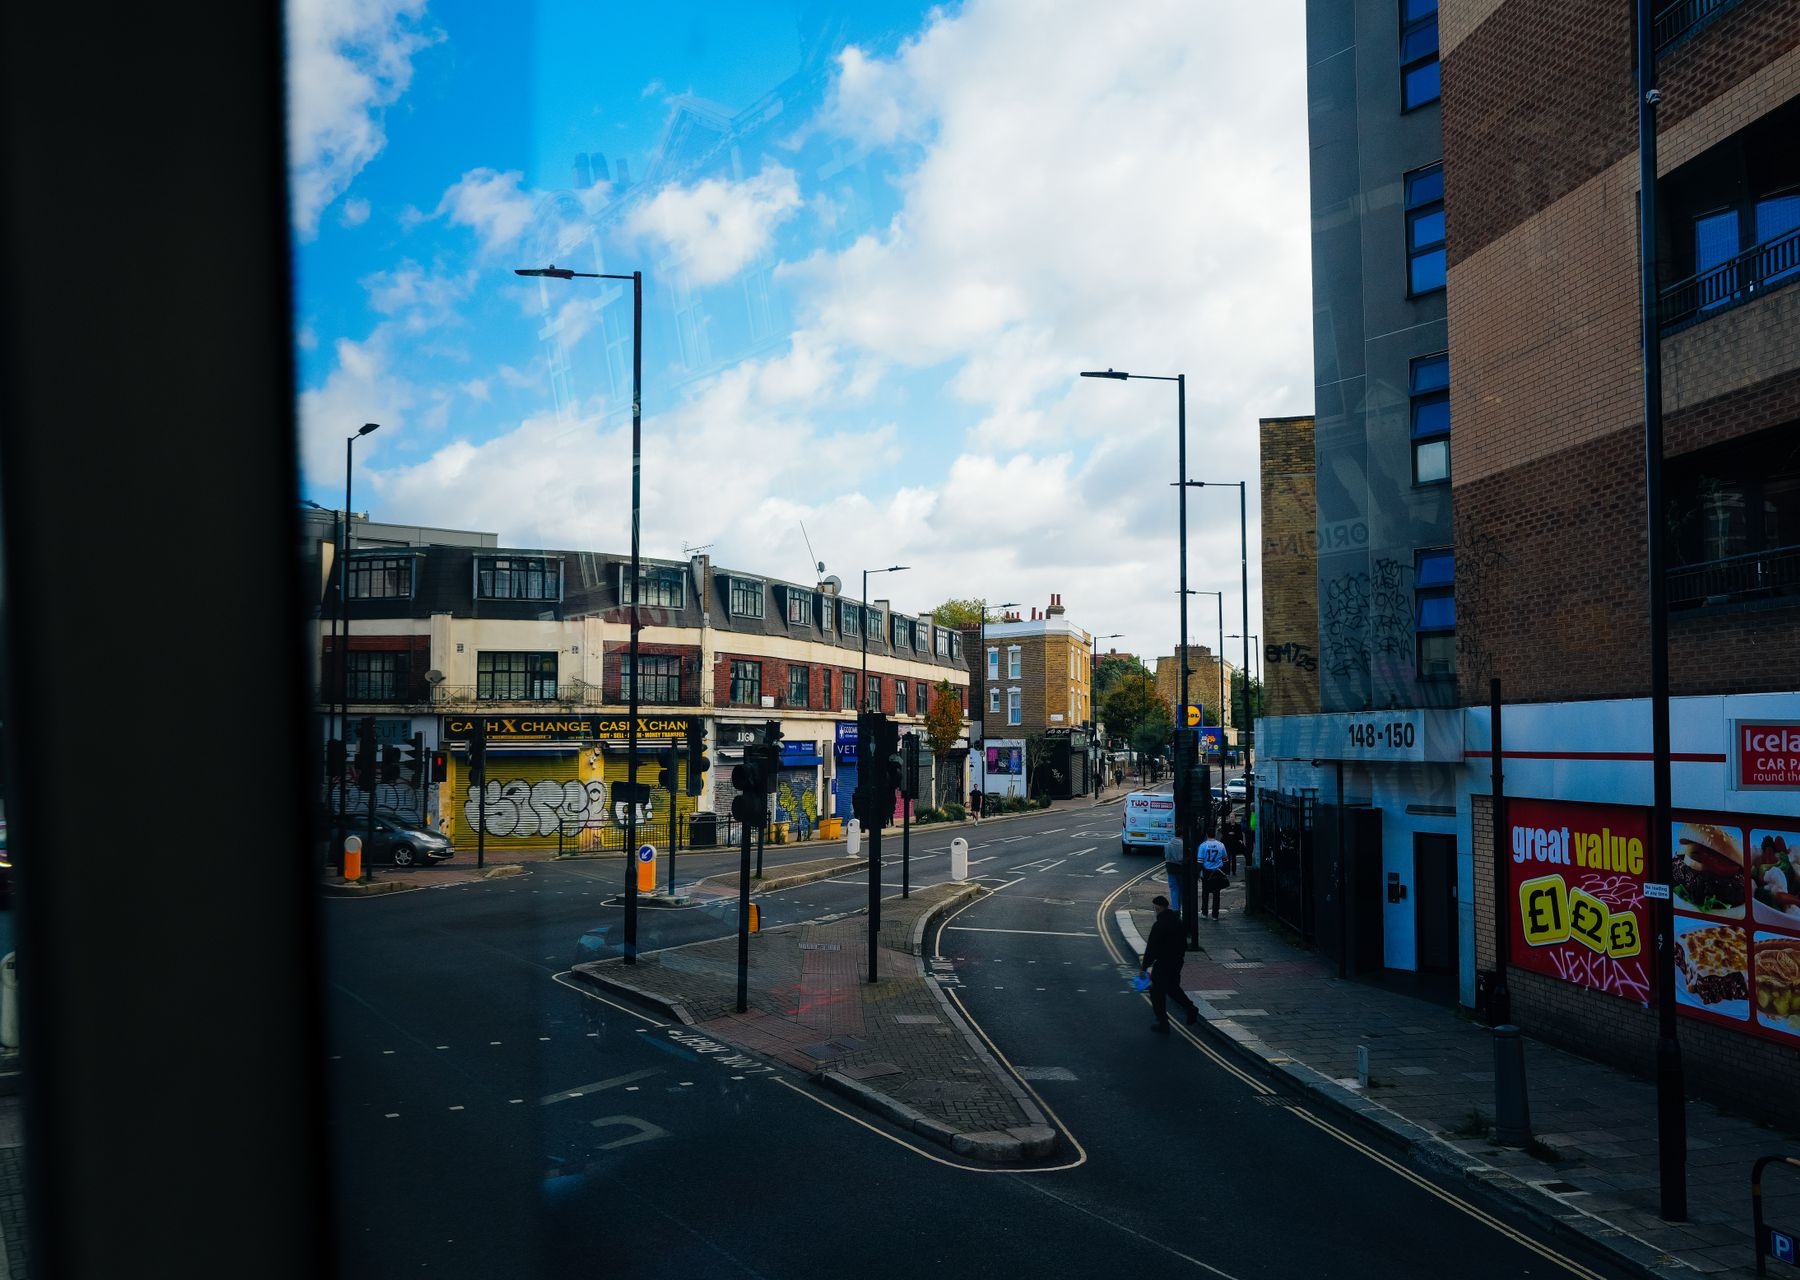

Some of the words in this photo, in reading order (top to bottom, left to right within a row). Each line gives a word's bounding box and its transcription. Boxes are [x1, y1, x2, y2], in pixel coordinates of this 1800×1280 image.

[450, 721, 499, 733] CAH
[520, 721, 592, 732] CHANGE
[599, 720, 630, 731] CAS
[649, 720, 689, 731] CHAN
[1757, 758, 1786, 770] CAR
[1753, 771, 1785, 781] round
[1206, 849, 1219, 863] 17
[1512, 825, 1571, 865] great
[1573, 827, 1644, 875] value
[1652, 885, 1667, 893] loading
[1529, 886, 1561, 934] £1
[1571, 900, 1602, 944] £2
[1610, 920, 1637, 950] £3
[1775, 1234, 1790, 1257] P
